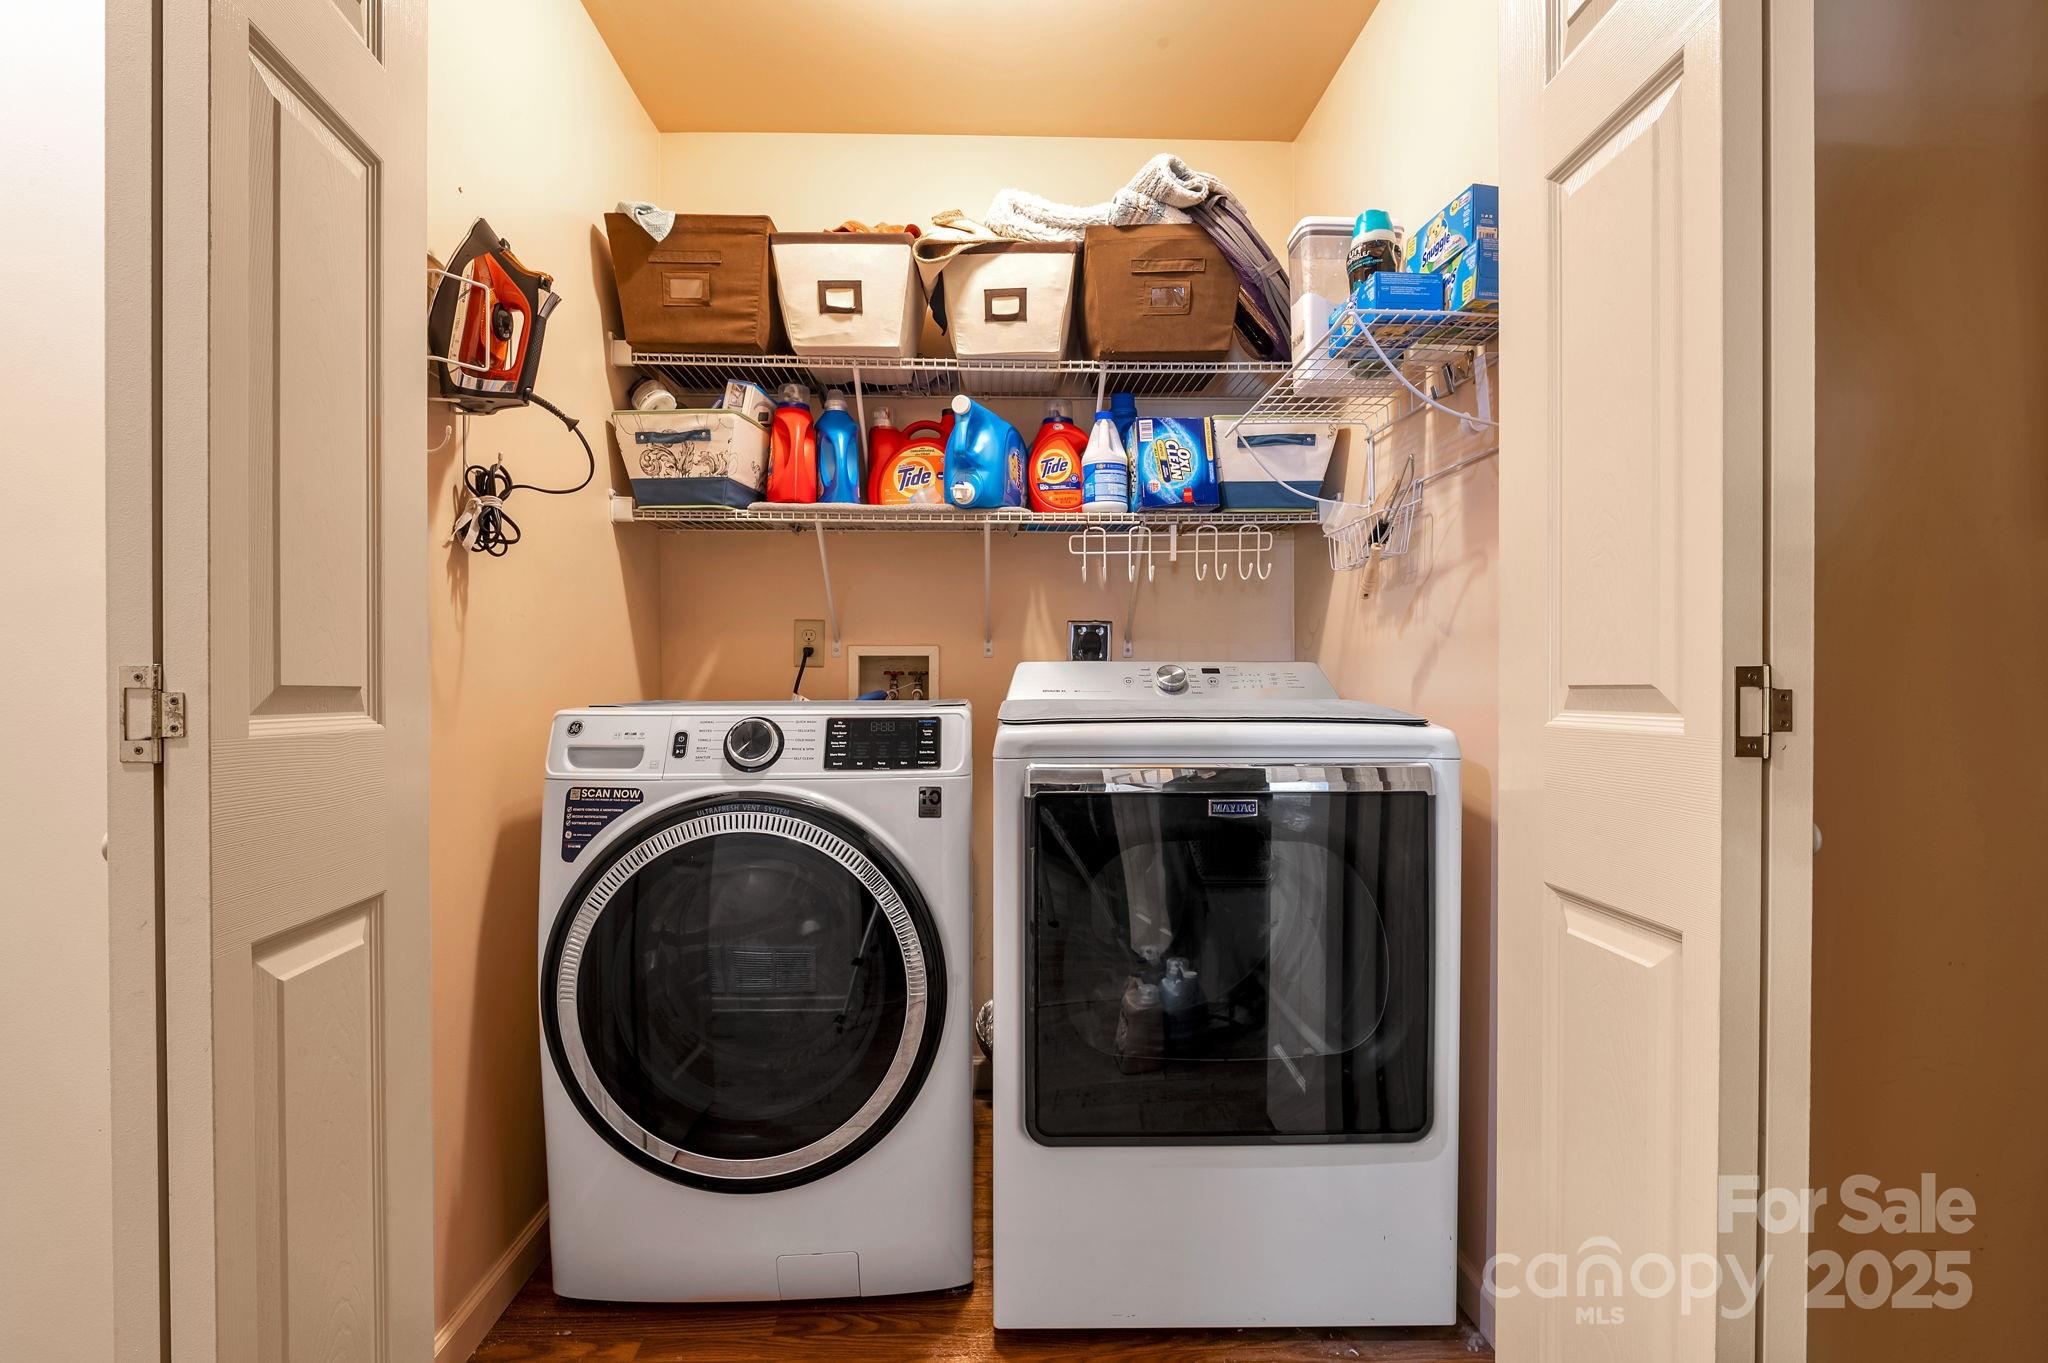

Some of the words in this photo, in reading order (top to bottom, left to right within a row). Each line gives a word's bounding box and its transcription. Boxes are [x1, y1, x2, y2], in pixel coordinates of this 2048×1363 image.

[1422, 232, 1451, 268] Snuggle
[1040, 457, 1069, 478] Tide
[1164, 440, 1183, 480] CLEAN
[1177, 448, 1192, 472] OXI
[898, 466, 931, 491] Tide
[581, 788, 610, 798] SCAN
[613, 789, 641, 799] NOW
[696, 803, 740, 817] ULTRAFRESH
[764, 805, 791, 816] SYSTEM
[1212, 803, 1255, 813] MAYTAG
